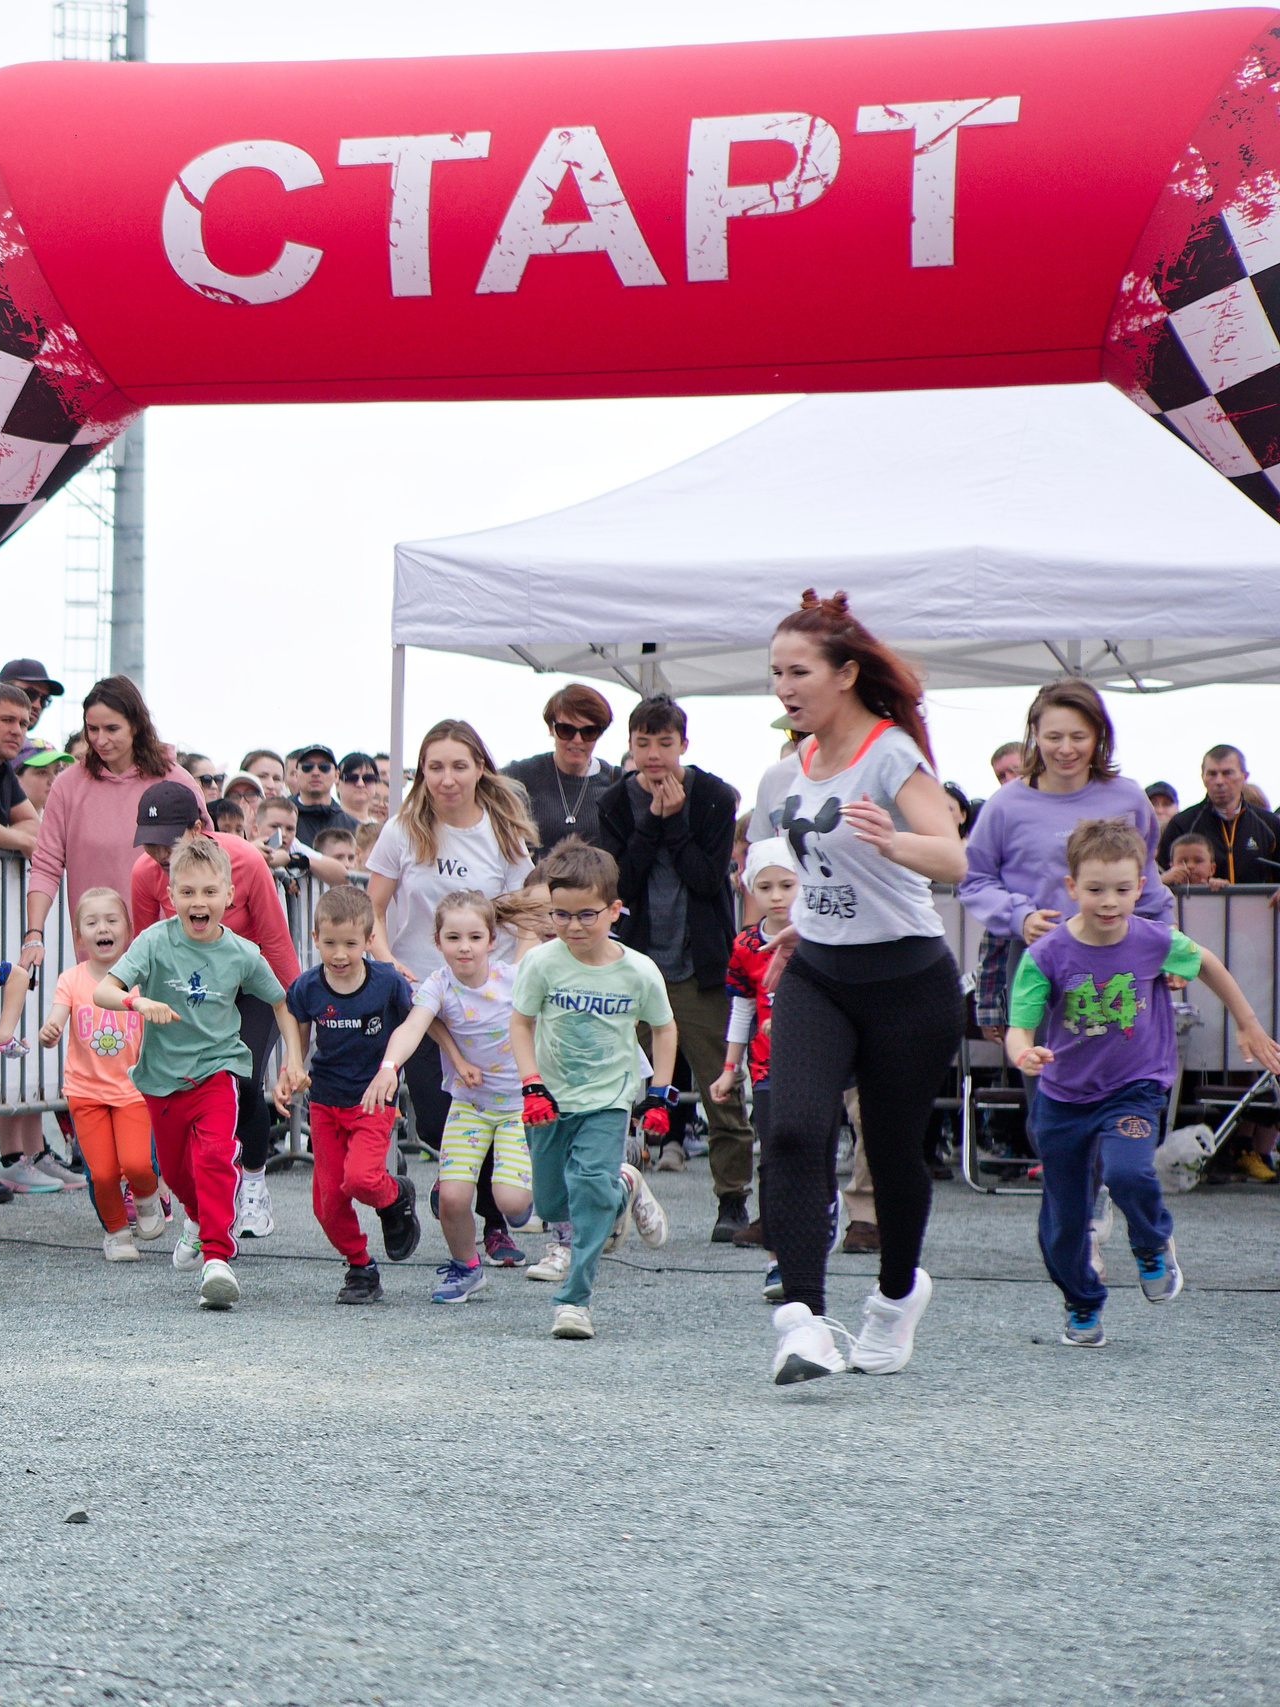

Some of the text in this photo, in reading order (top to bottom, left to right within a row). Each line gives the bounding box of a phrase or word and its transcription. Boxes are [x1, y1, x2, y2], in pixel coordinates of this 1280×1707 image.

[161, 95, 1021, 306] СТАРТ
[436, 858, 468, 877] We
[77, 1004, 140, 1042] GAP
